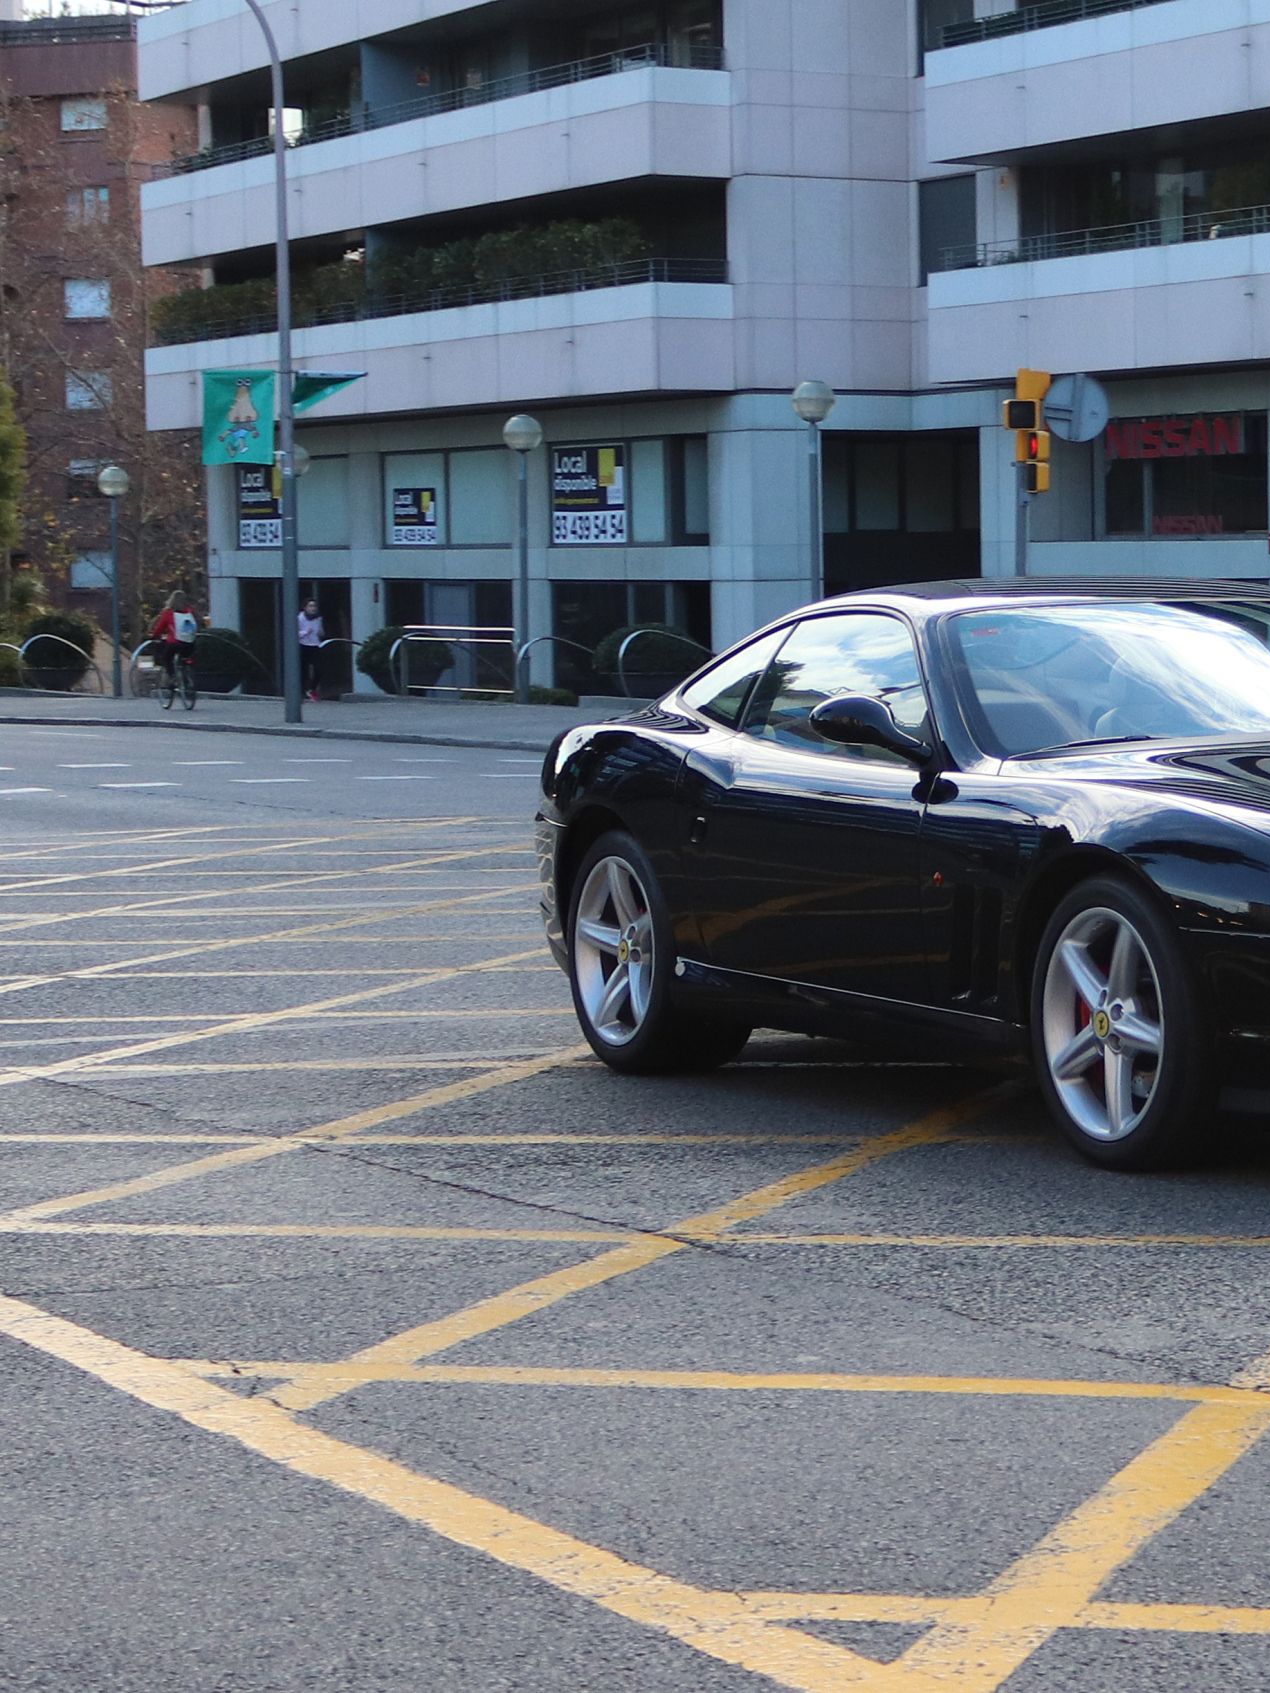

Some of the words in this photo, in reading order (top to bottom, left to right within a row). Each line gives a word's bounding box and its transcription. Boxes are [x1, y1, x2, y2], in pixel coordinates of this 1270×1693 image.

[1106, 418, 1240, 459] NISSAN
[554, 450, 587, 473] Local
[241, 467, 265, 488] Local
[554, 475, 597, 493] disponible
[555, 515, 567, 540] 93
[569, 515, 591, 540] 439
[594, 514, 608, 539] 54
[611, 514, 624, 539] 54
[1153, 515, 1223, 535] NISSAN
